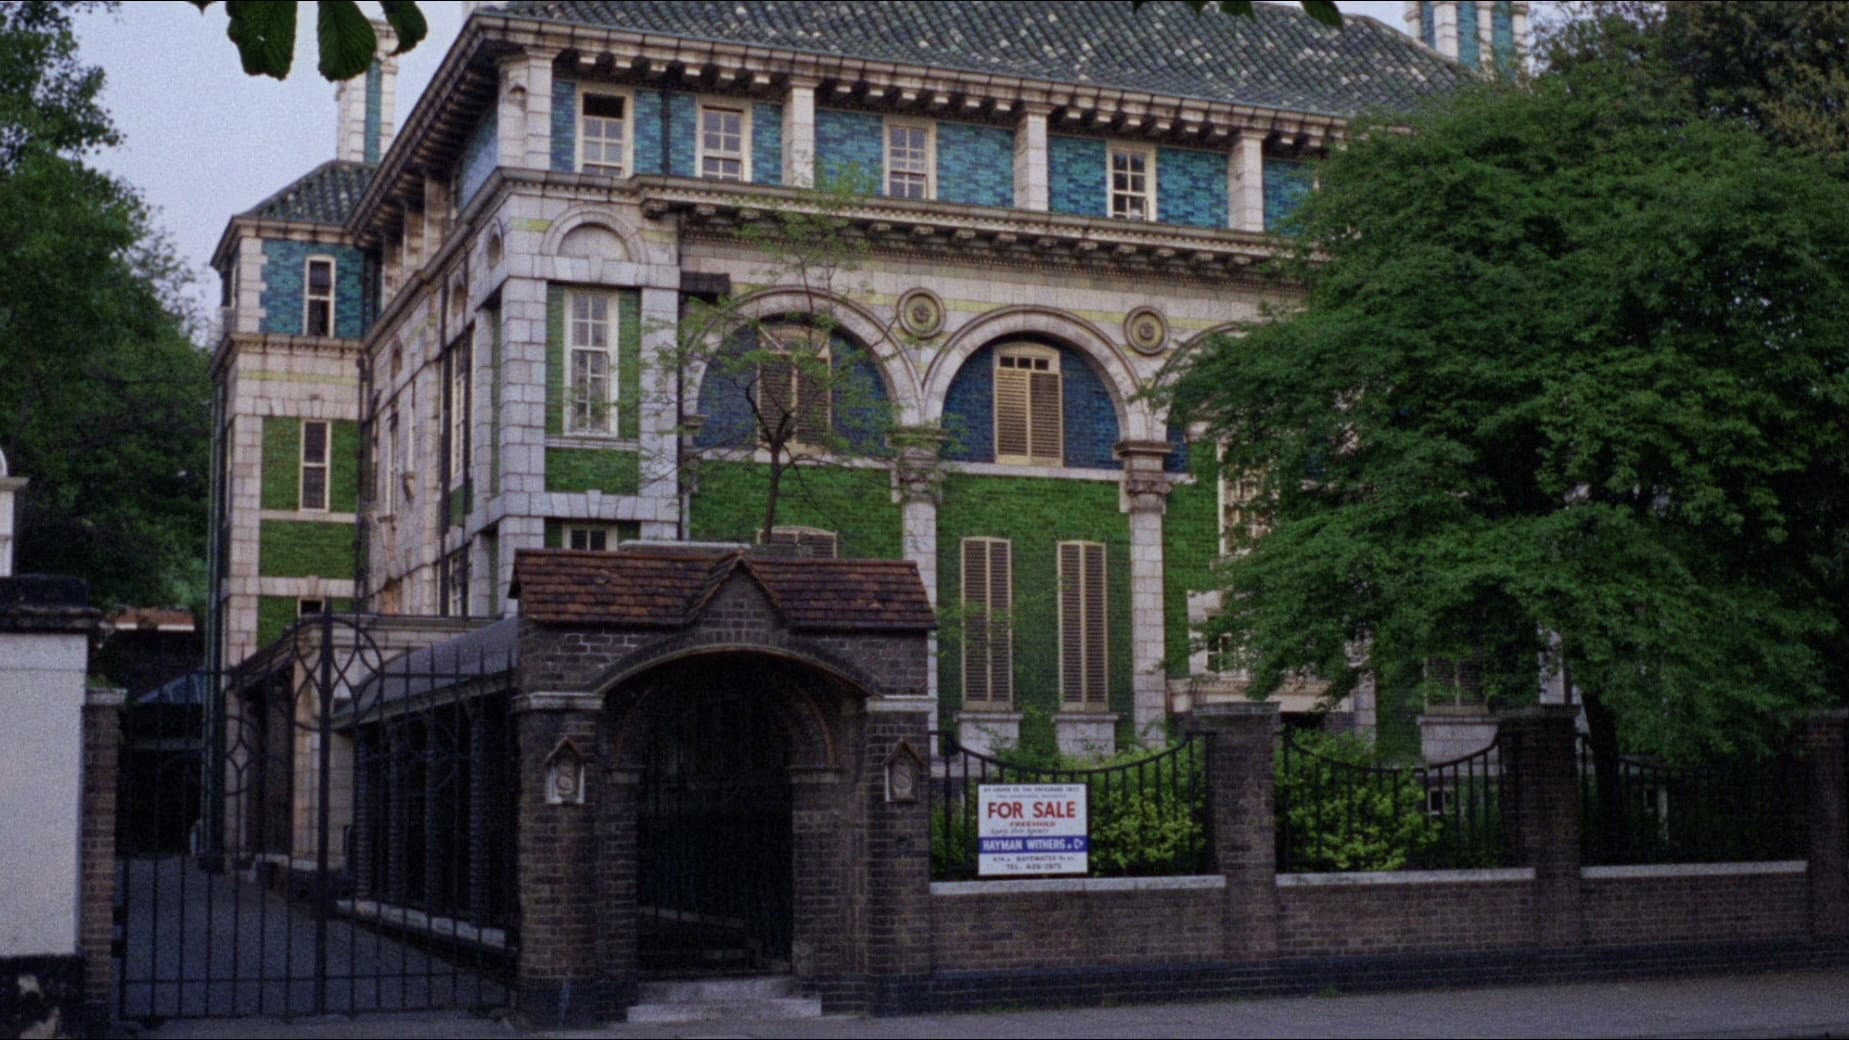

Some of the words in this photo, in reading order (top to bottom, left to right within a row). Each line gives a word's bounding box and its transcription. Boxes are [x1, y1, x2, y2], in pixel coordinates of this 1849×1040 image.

[987, 801, 1024, 819] FOR
[1032, 801, 1077, 818] SALE
[982, 839, 1023, 851] HAYMAN
